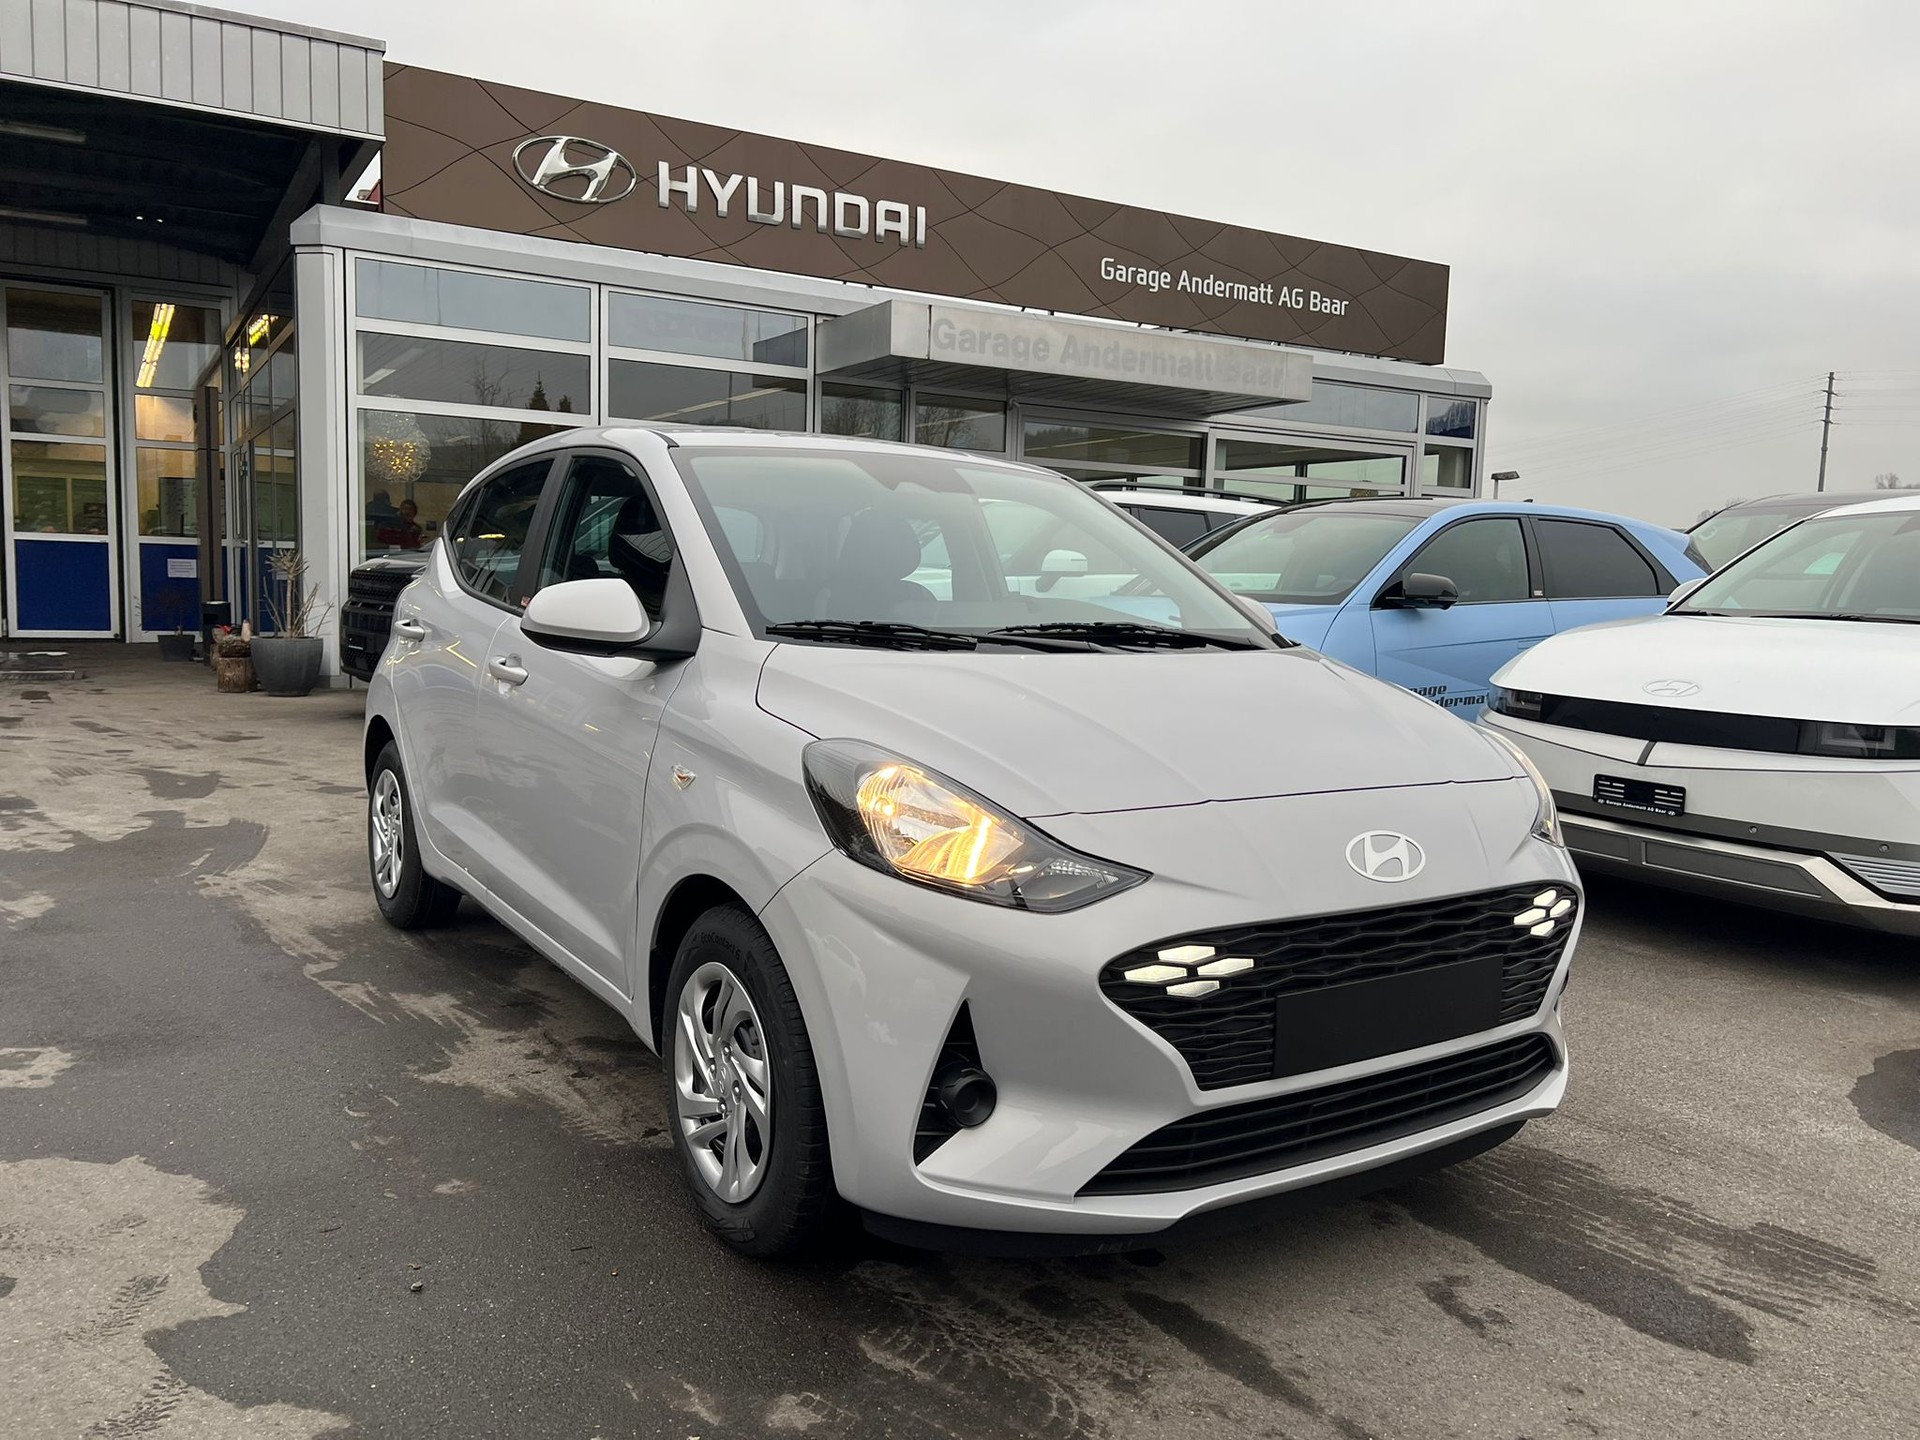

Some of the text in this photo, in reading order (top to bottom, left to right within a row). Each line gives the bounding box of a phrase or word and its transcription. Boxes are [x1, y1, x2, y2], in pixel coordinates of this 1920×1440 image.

[658, 160, 926, 249] HYUNDAI
[1101, 258, 1350, 316] Garage Andermatt AG Baar
[932, 317, 1050, 363] Garage
[1059, 333, 1214, 382] Andermatt
